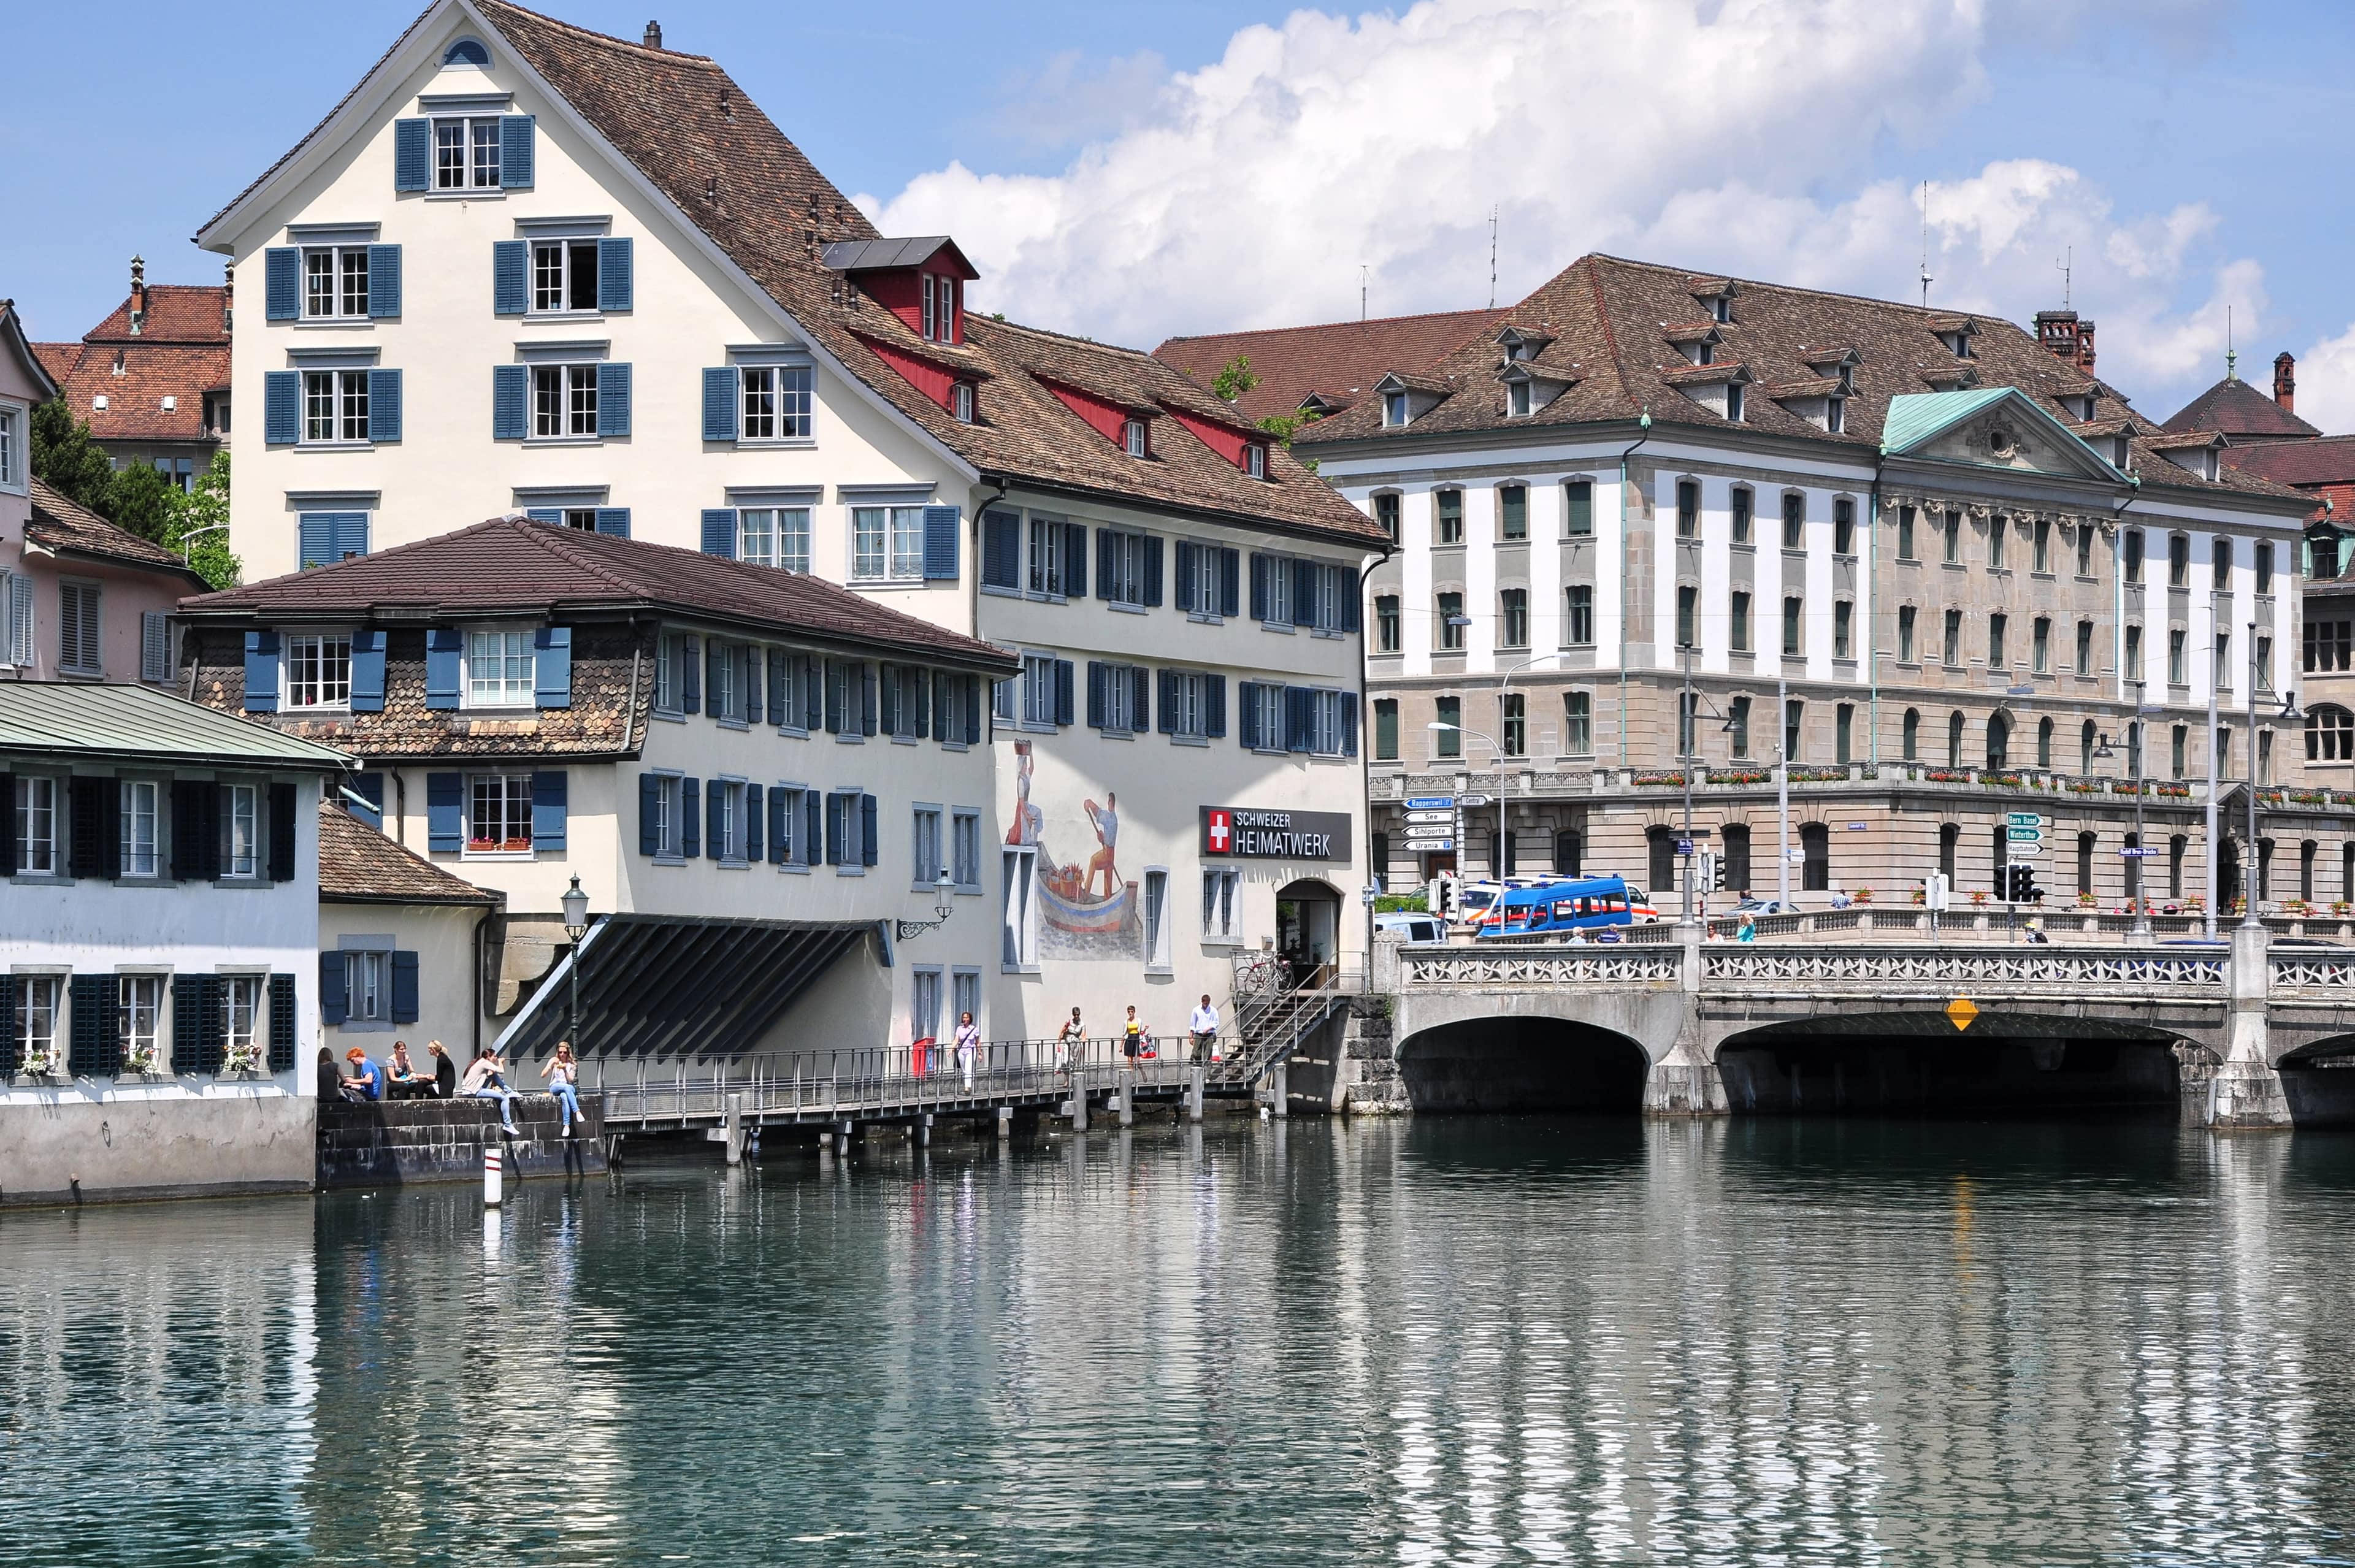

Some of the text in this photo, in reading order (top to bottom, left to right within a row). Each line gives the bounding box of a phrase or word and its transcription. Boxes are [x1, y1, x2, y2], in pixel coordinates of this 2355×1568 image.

[1236, 812, 1291, 828] SCHWEIZER
[2009, 816, 2037, 825] Bern Basel
[2010, 830, 2037, 839] Winterthur
[1236, 831, 1330, 857] HEIMATWERK
